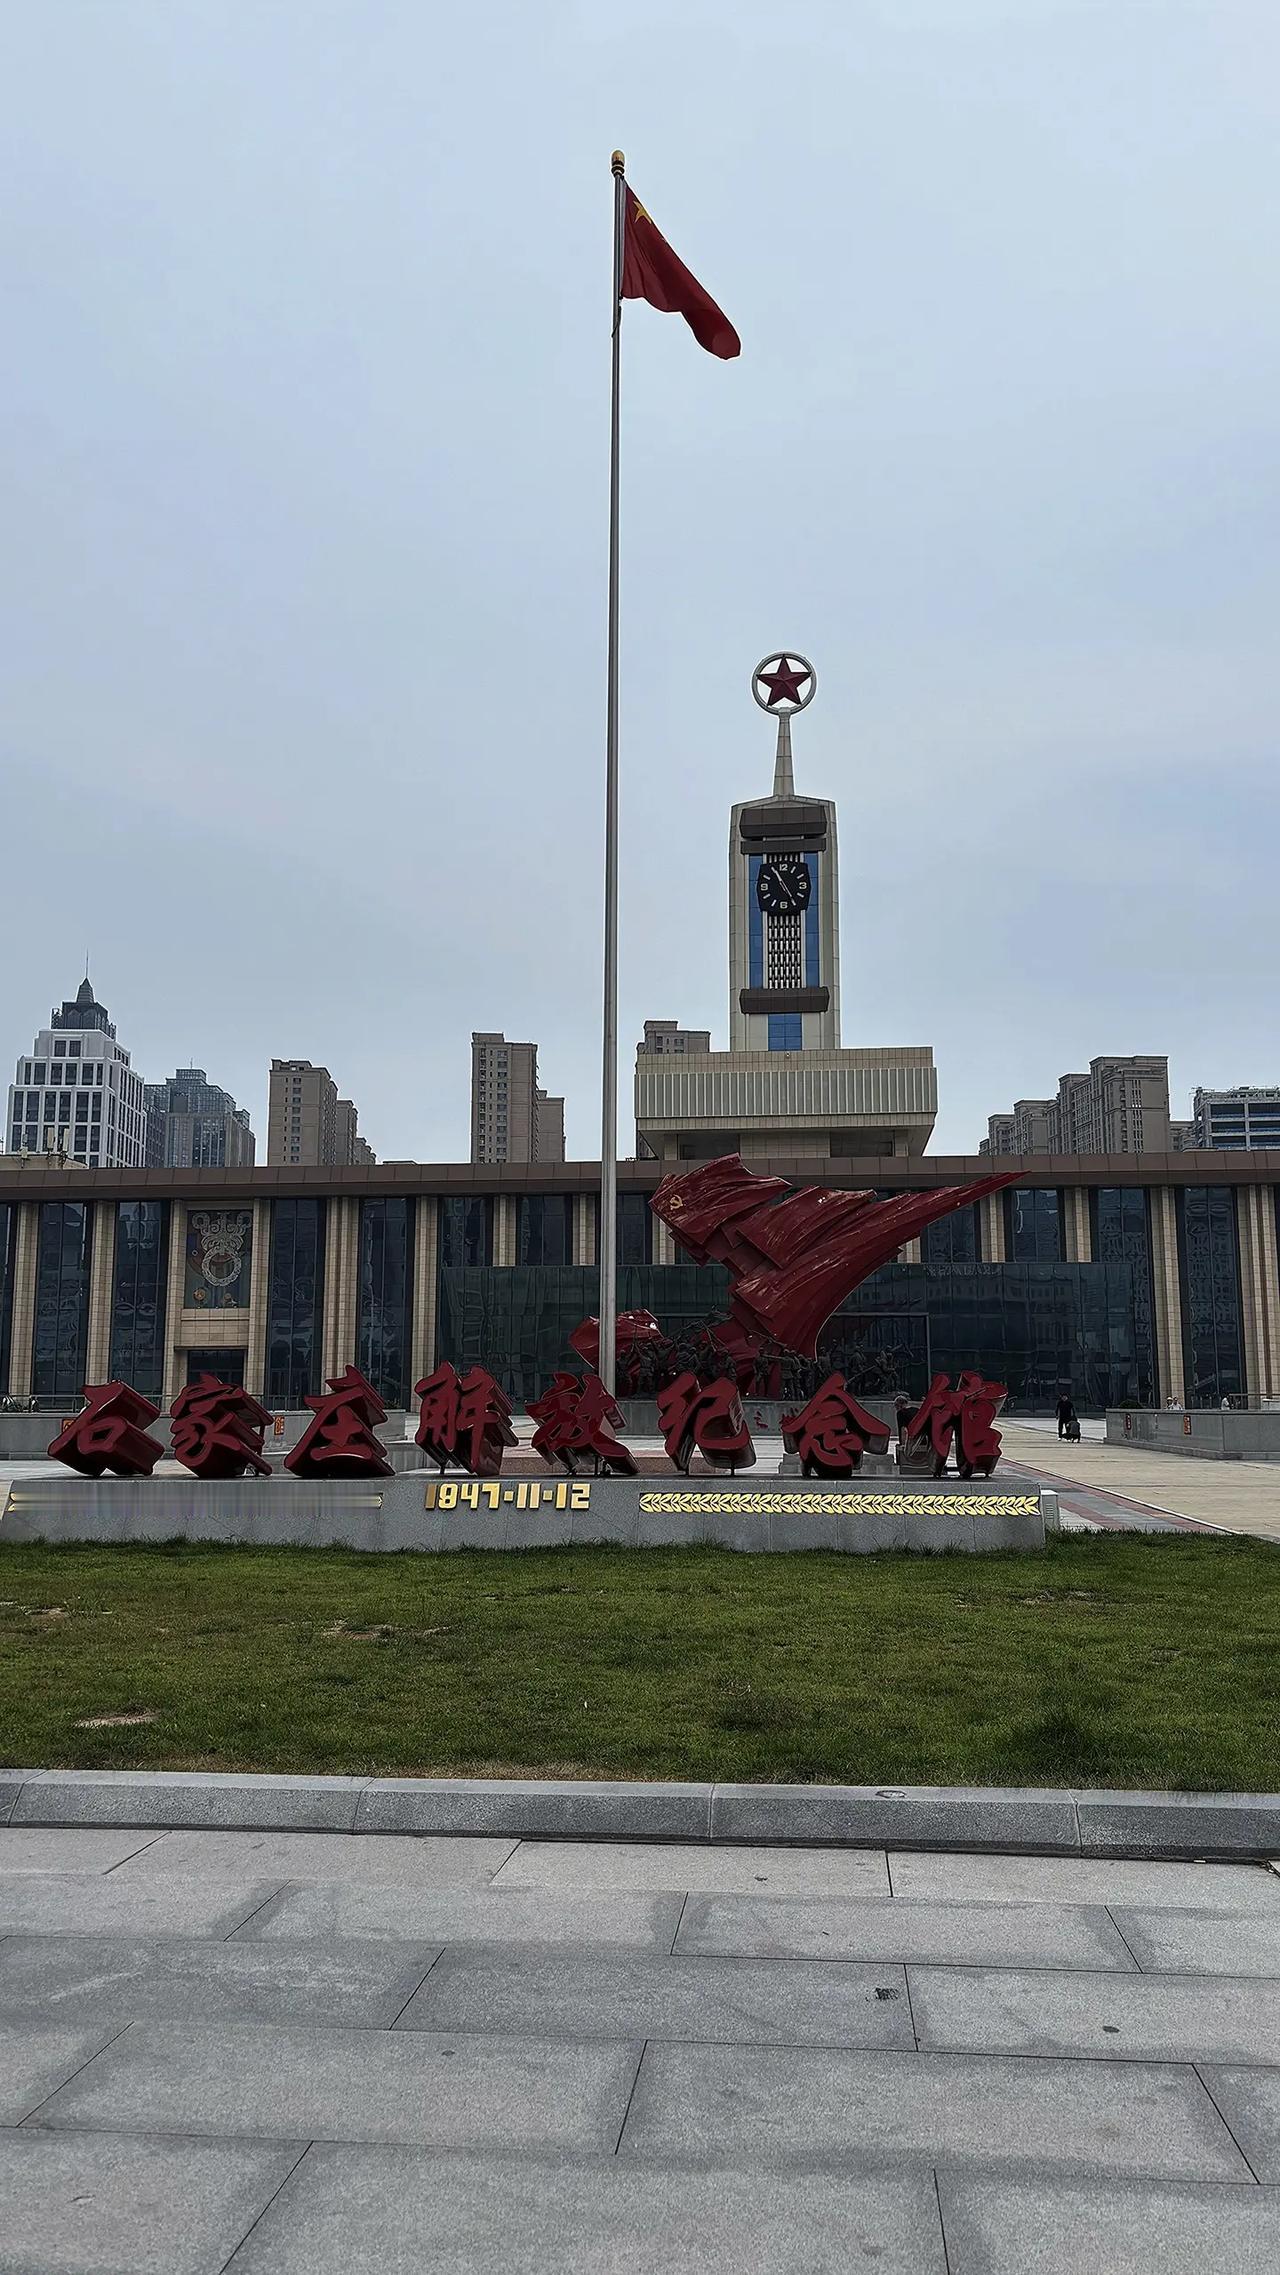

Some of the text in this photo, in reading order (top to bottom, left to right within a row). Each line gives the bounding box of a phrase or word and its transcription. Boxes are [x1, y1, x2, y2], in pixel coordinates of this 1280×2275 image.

[48, 1361, 1007, 1477] 石家庄解放纪念馆
